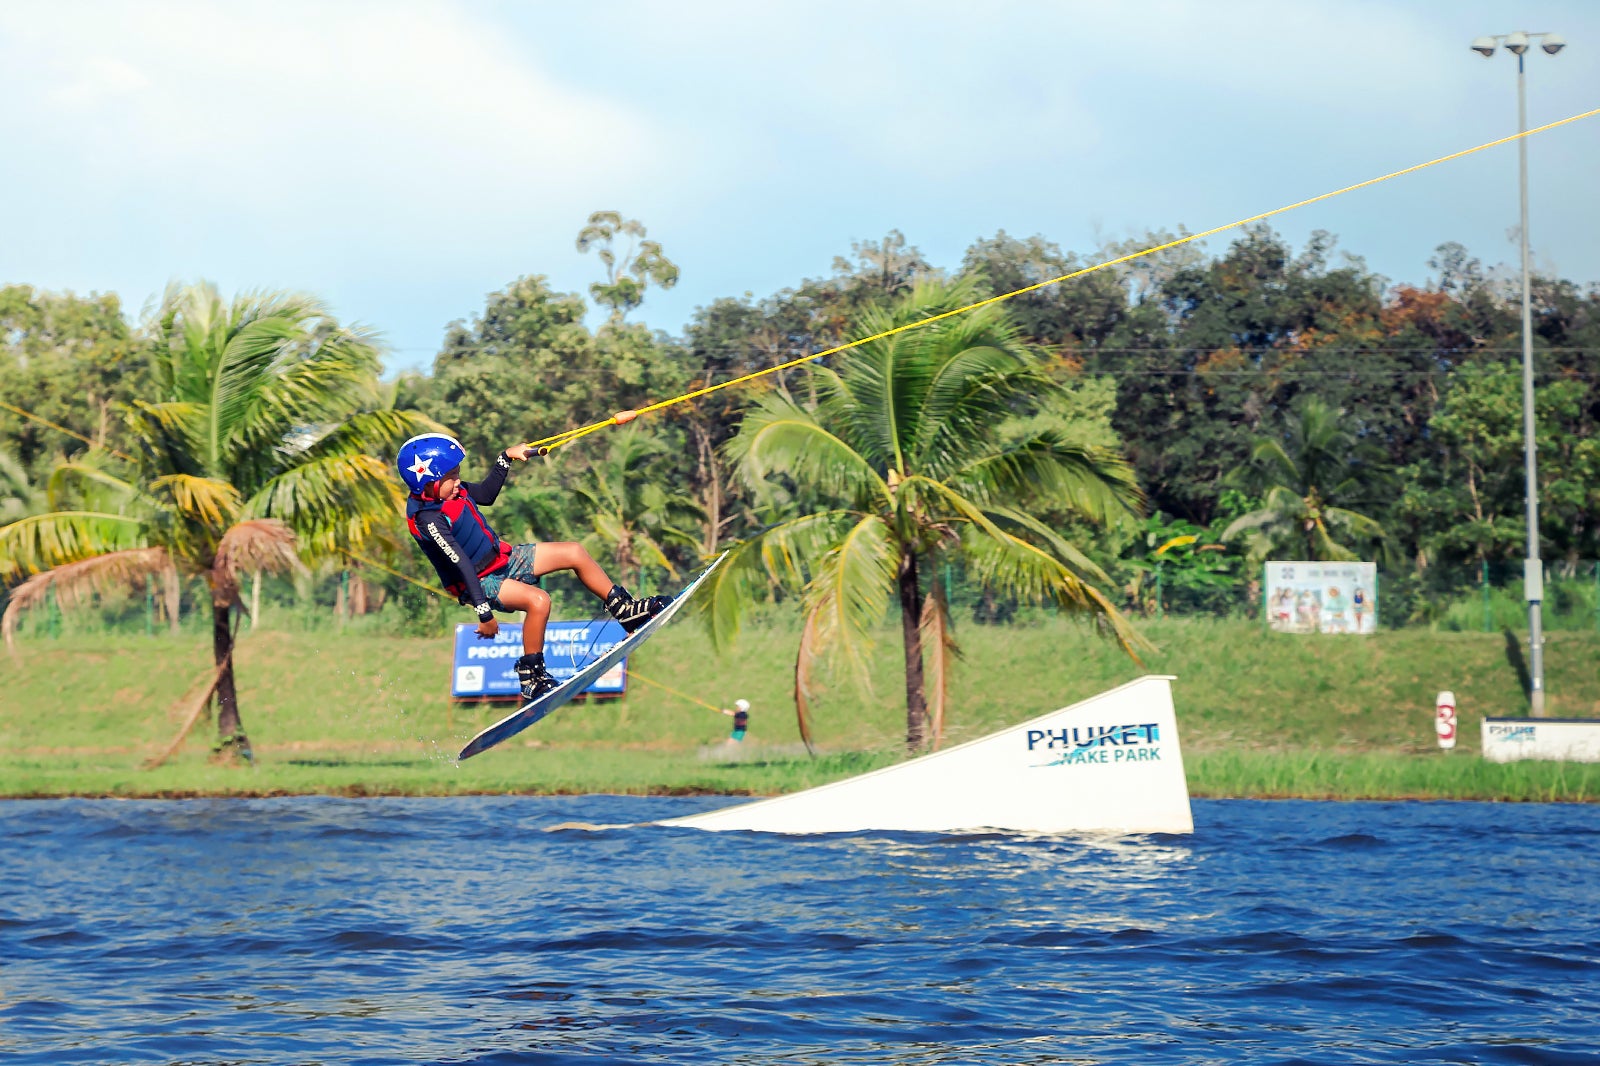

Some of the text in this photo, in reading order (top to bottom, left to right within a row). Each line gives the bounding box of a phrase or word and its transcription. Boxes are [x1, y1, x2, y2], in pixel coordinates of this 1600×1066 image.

[427, 522, 460, 564] QUIKSILVER
[550, 642, 590, 657] WITH
[1027, 722, 1159, 751] PHUKET
[1437, 704, 1455, 740] 3
[1059, 747, 1161, 765] WAKE PARK
